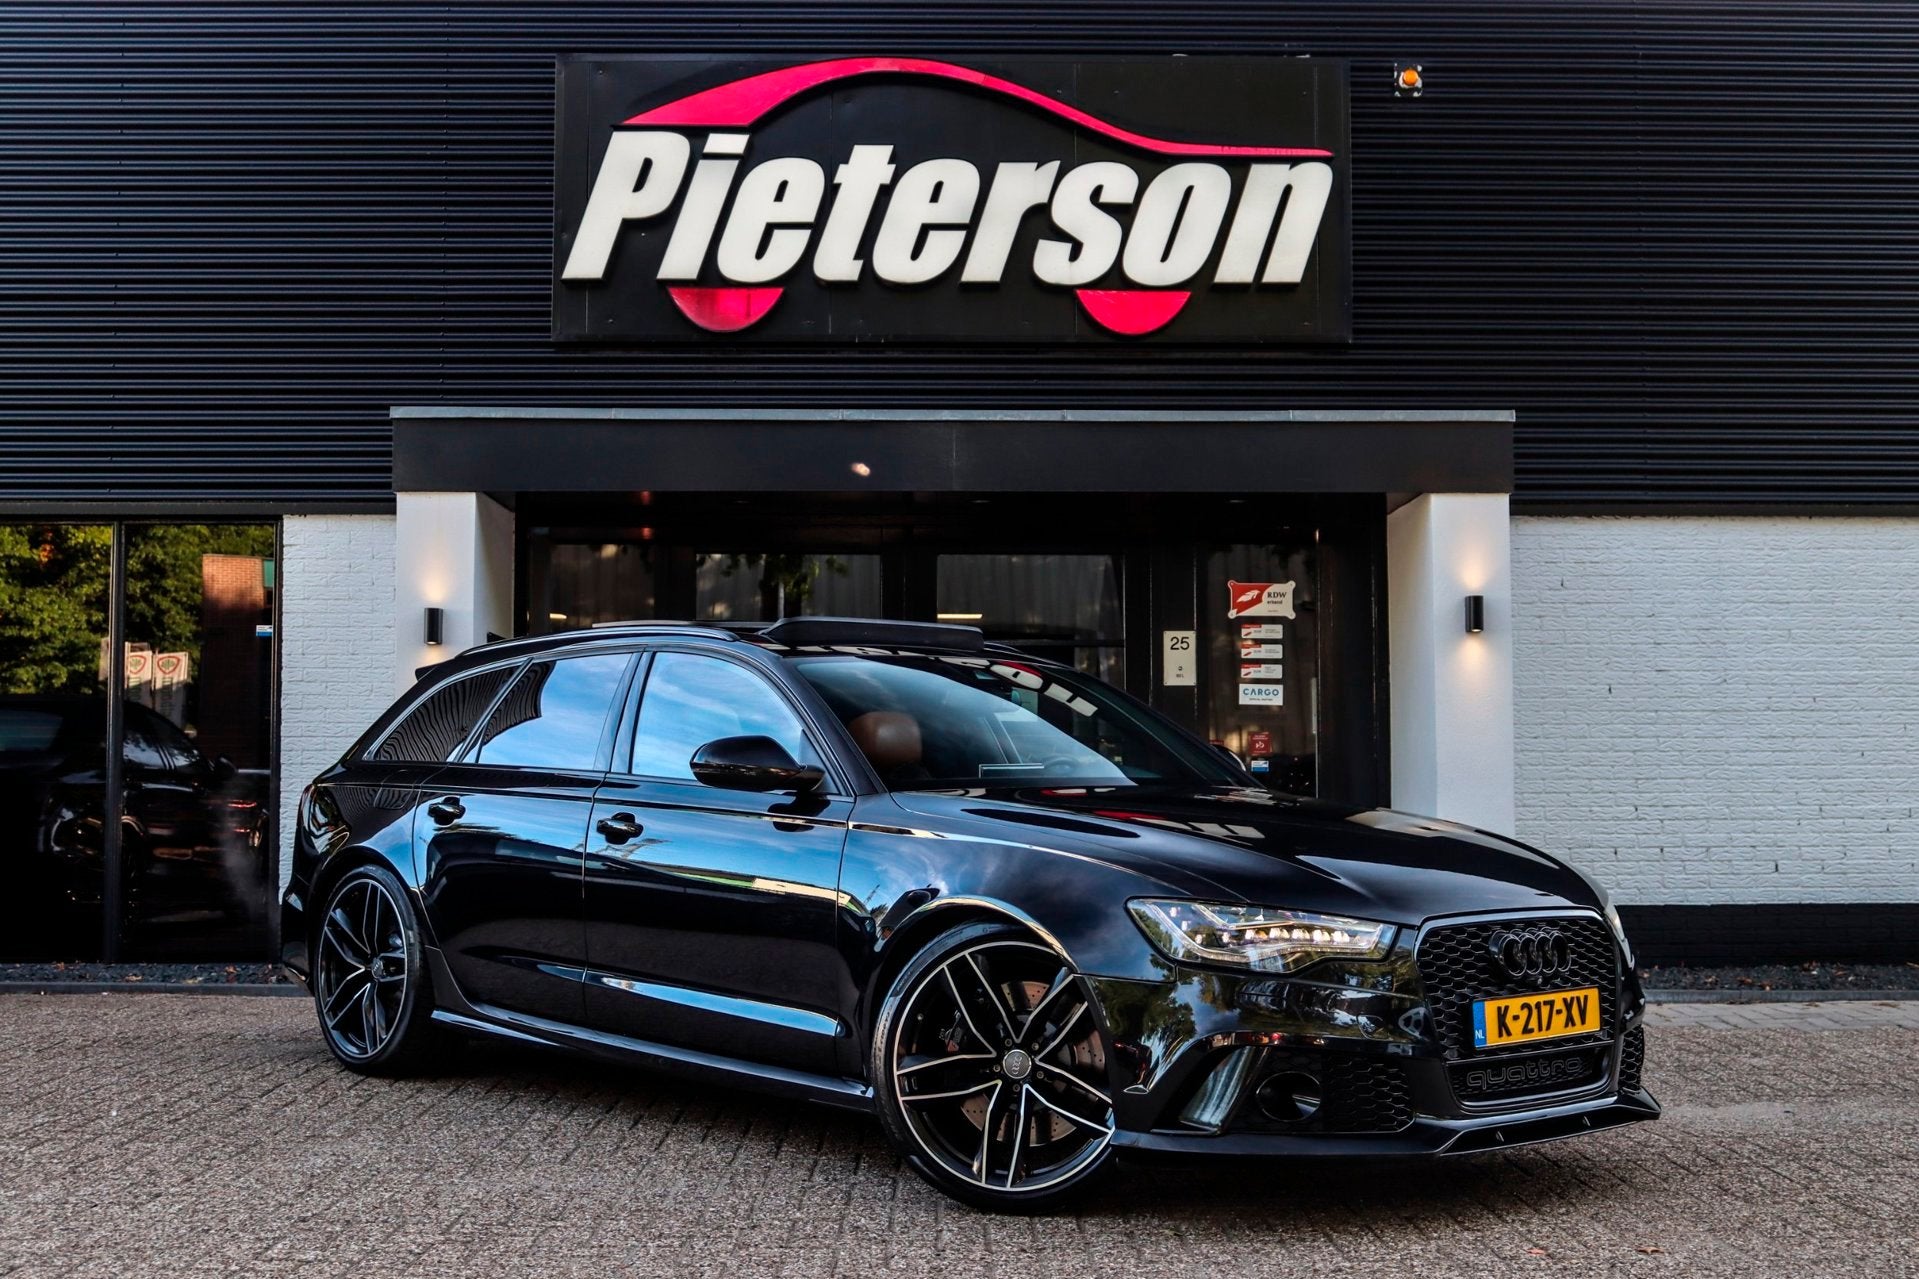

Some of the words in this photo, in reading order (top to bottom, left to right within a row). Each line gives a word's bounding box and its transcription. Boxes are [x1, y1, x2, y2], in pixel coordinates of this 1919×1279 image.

[561, 130, 1335, 287] Pieterson
[1170, 636, 1190, 650] 25
[1243, 688, 1280, 697] CARGO
[1497, 994, 1589, 1038] K-217-XV
[1475, 1029, 1485, 1039] NL
[1467, 1057, 1581, 1090] quattro
